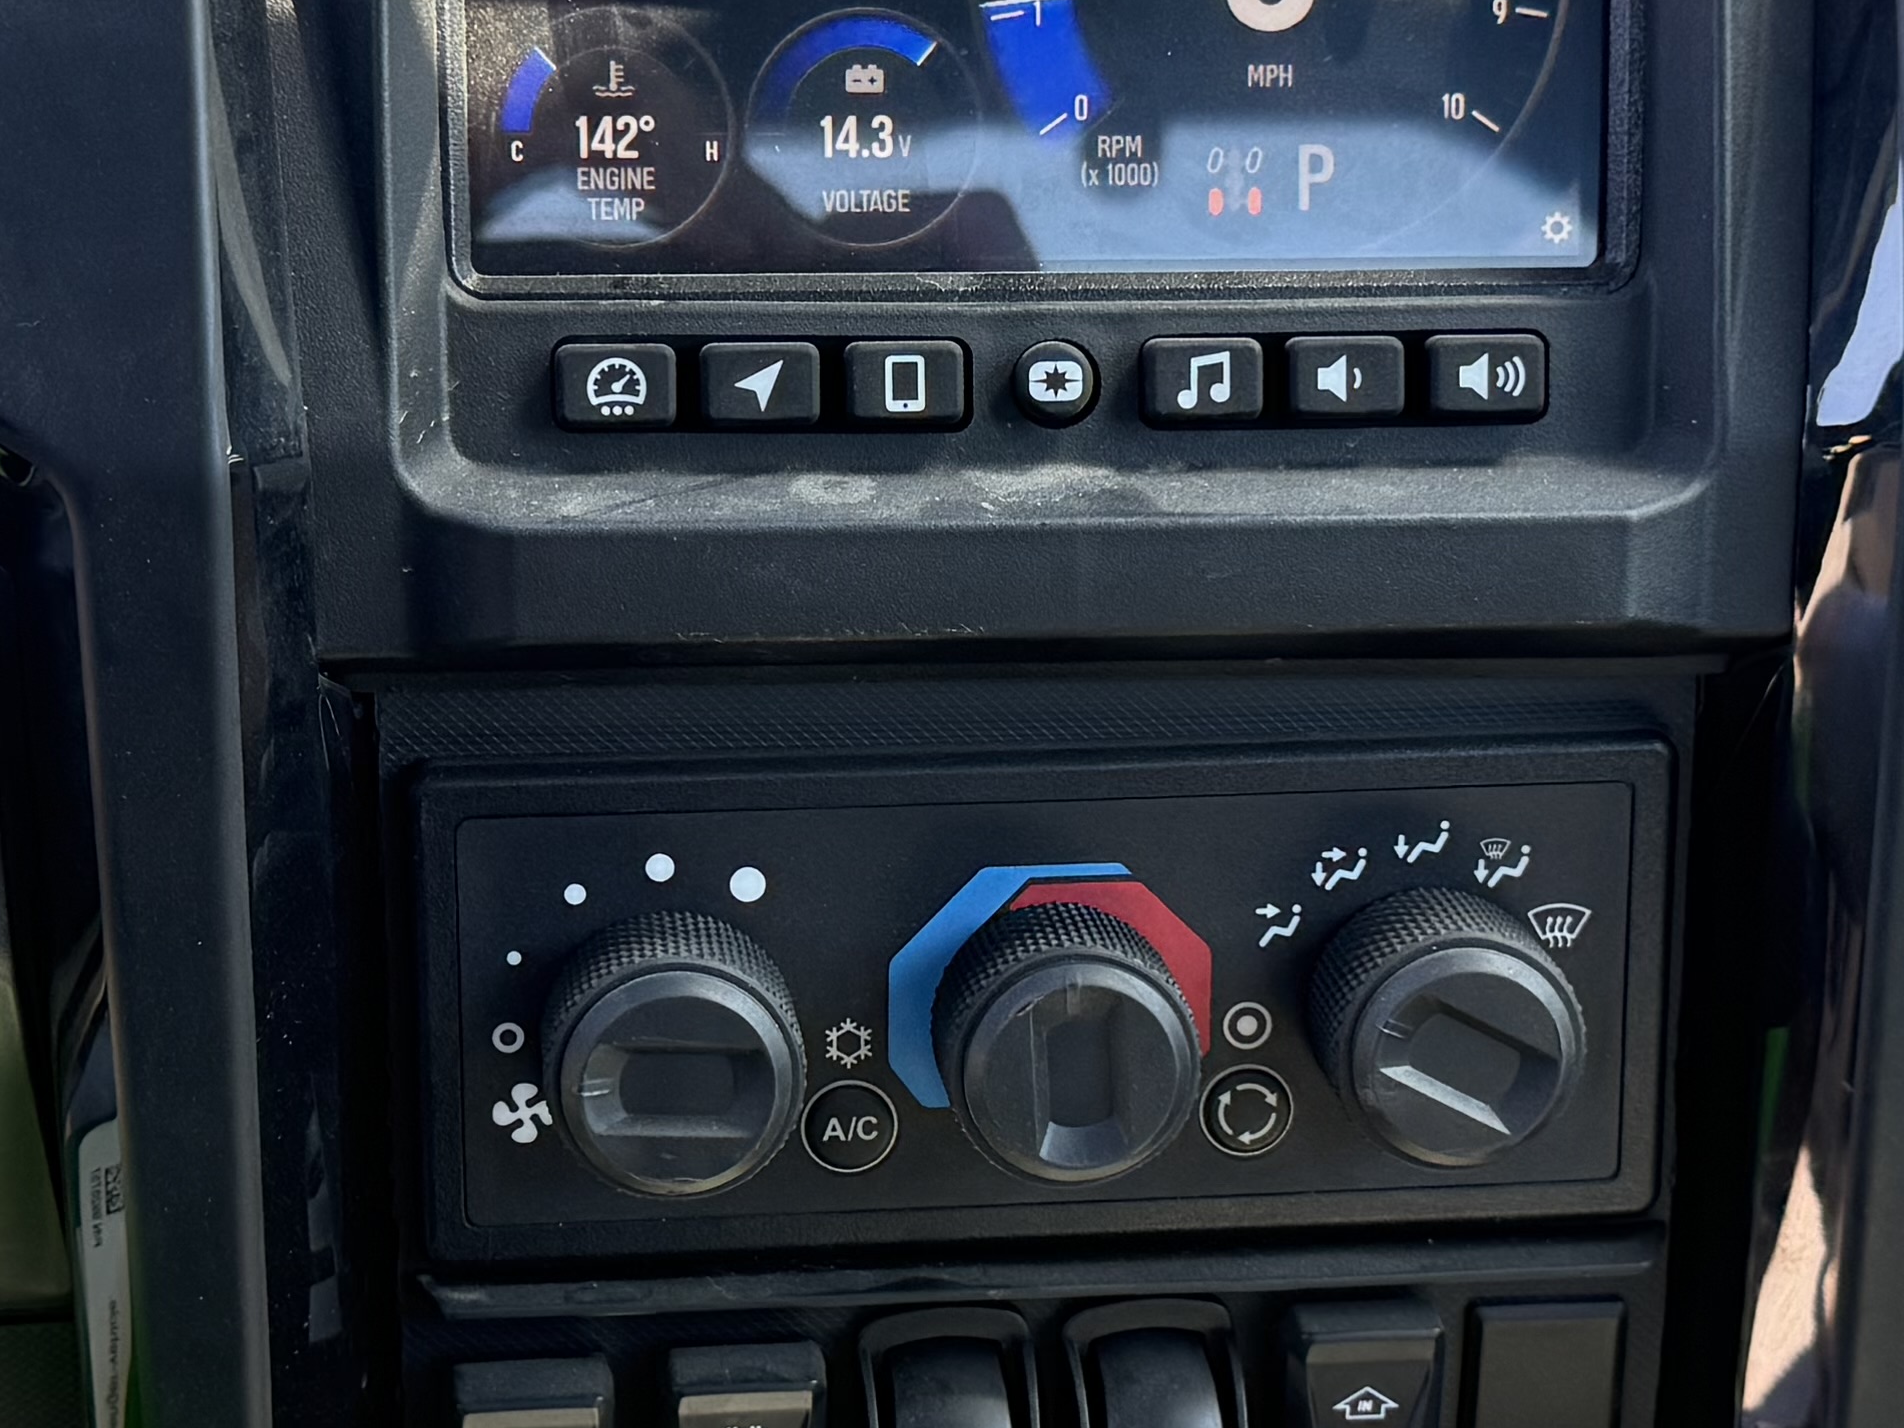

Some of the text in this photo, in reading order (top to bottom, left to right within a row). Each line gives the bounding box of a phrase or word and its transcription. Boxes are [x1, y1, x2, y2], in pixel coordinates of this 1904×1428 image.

[1034, 0, 1042, 27] 1
[1247, 64, 1293, 88] MPH
[1074, 94, 1088, 121] 0
[1442, 93, 1466, 120] 10
[575, 114, 656, 160] 142°
[820, 115, 912, 160] 14.3 V
[1096, 135, 1143, 159] RPM
[510, 141, 524, 163] C
[705, 140, 719, 163] H
[576, 167, 655, 191] ENGINE
[1080, 162, 1160, 187] (x 1000)
[1298, 143, 1335, 211] P
[587, 198, 645, 221] TEMP
[822, 189, 911, 215] VOLTAGE
[821, 1113, 880, 1145] A/C
[1355, 1398, 1376, 1414] IN
